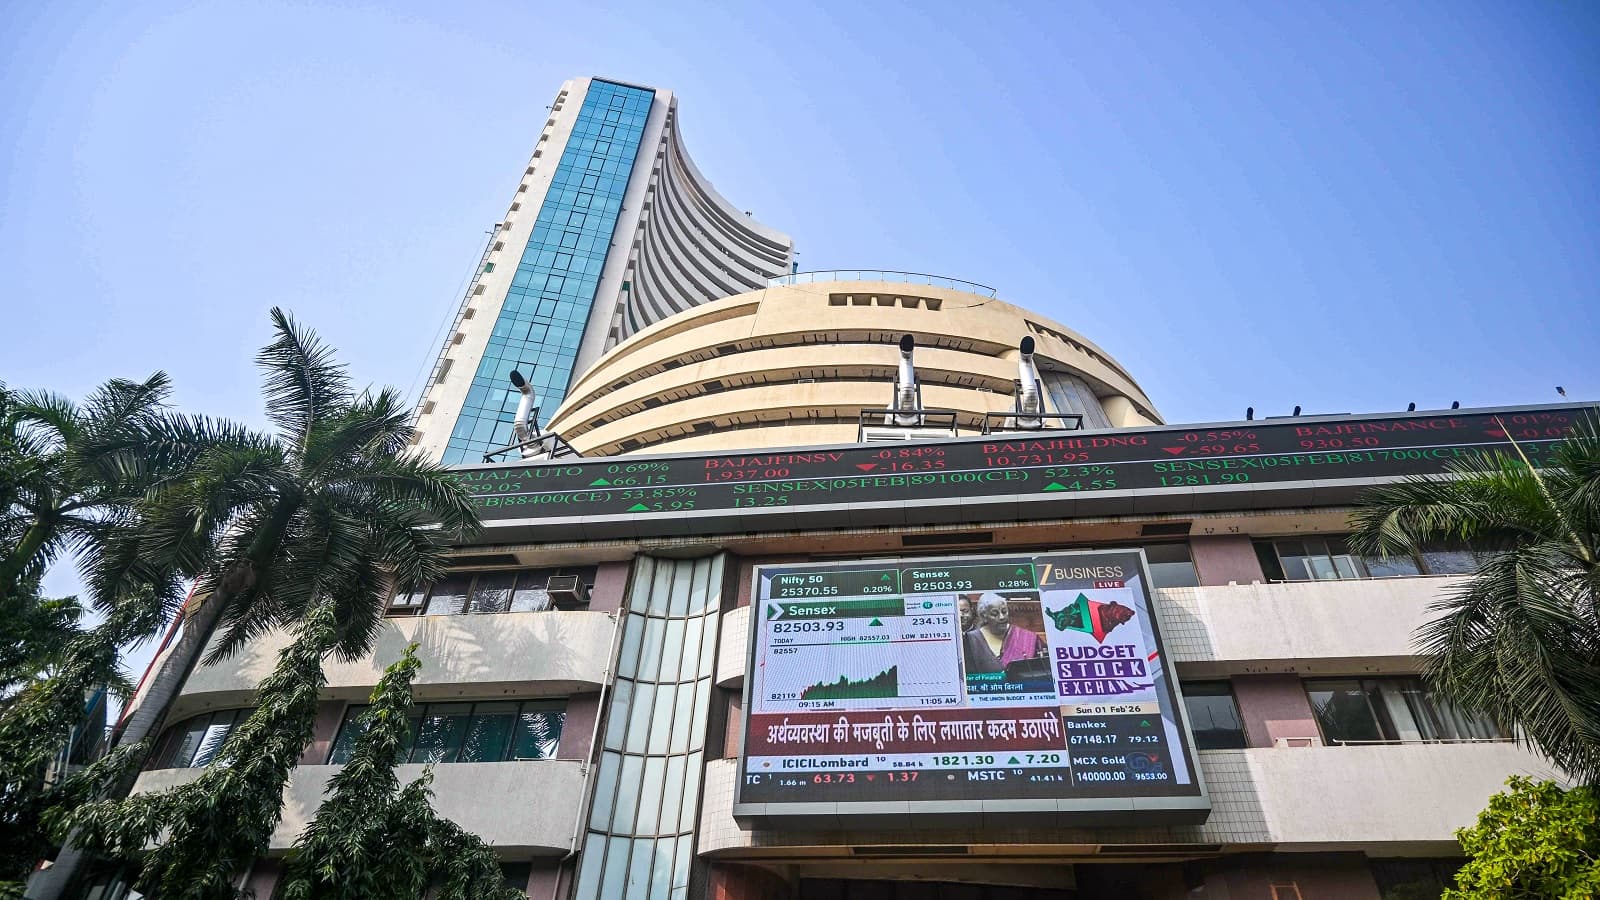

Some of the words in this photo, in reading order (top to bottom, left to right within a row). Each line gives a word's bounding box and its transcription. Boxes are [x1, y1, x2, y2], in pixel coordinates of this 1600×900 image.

[1296, 418, 1466, 436] BAJFINANCE
[983, 436, 1148, 454] BAJAJHLDNG
[1176, 431, 1257, 442] -0.55%
[1191, 443, 1260, 455] -59.65
[705, 452, 844, 469] BAJAJFINSV
[872, 447, 945, 459] -0.84%
[607, 462, 669, 474] 0.69%
[880, 460, 945, 471] -16.35
[1044, 466, 1115, 478] 52.3%
[612, 474, 666, 486] 66.15
[1160, 473, 1249, 487] 1281.90
[621, 487, 697, 500] 53.85%
[735, 496, 788, 508] 13.25
[1069, 480, 1117, 490] 4.55
[651, 500, 695, 511] 5.95
[912, 571, 950, 579] Sensex
[1054, 566, 1124, 580] BUSINESS
[781, 576, 805, 586] Nifty
[808, 575, 823, 583] 50
[913, 580, 973, 591] 82503.93
[998, 580, 1030, 588] 0.28%
[781, 586, 838, 597] 25370.55
[863, 585, 892, 593] 0.20%
[789, 605, 837, 616] Sensex
[773, 621, 844, 633] 82503.93
[912, 617, 949, 626] 234.15
[1056, 645, 1136, 660] BUDGET
[1060, 661, 1143, 678] STOCK
[771, 692, 796, 700] 82119
[798, 701, 821, 709] 09:15
[767, 717, 830, 744] अर्थव्यवस्था
[833, 716, 850, 743] की
[852, 715, 894, 750] मजबूती
[896, 715, 910, 741] के
[912, 714, 937, 744] लिए
[939, 720, 984, 741] लगातार
[986, 719, 1017, 741] कदम
[1019, 711, 1060, 742] उठाएंगे
[1067, 720, 1107, 729] Bankex
[1070, 734, 1117, 744] 67148.17
[1127, 735, 1159, 743] 79.12
[782, 757, 869, 769] ICICILombard
[933, 755, 995, 766] 1821.30
[1025, 754, 1061, 764] 7.20
[1073, 757, 1098, 765] MCX
[1101, 756, 1126, 765] Gold
[813, 773, 855, 783] 63.73
[887, 771, 919, 782] 1.37
[967, 770, 1006, 781] MSTC
[1076, 771, 1126, 782] 140000.00
[1135, 772, 1168, 780] 9653.00
